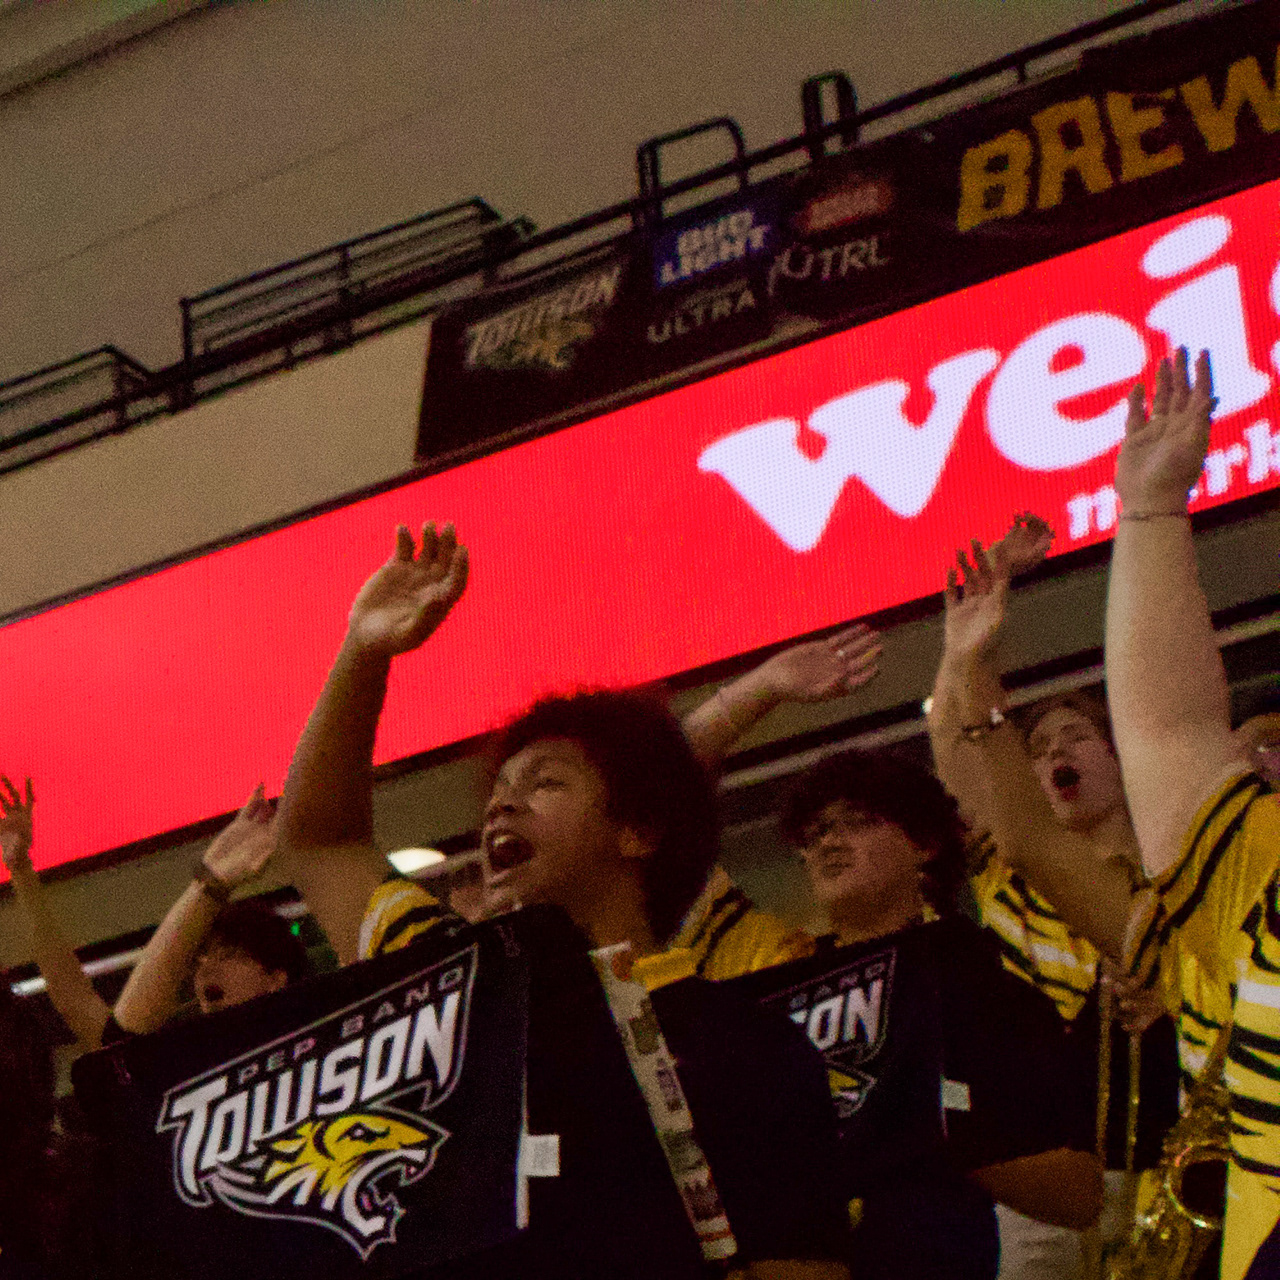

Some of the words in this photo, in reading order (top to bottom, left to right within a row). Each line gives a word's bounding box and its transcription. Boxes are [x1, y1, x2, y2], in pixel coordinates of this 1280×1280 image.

[646, 289, 756, 344] ULTRA
[696, 215, 1280, 554] wei
[238, 1037, 316, 1085] PEP
[340, 966, 464, 1040] BAND
[789, 978, 883, 1050] ON
[172, 991, 462, 1196] TOWSON
